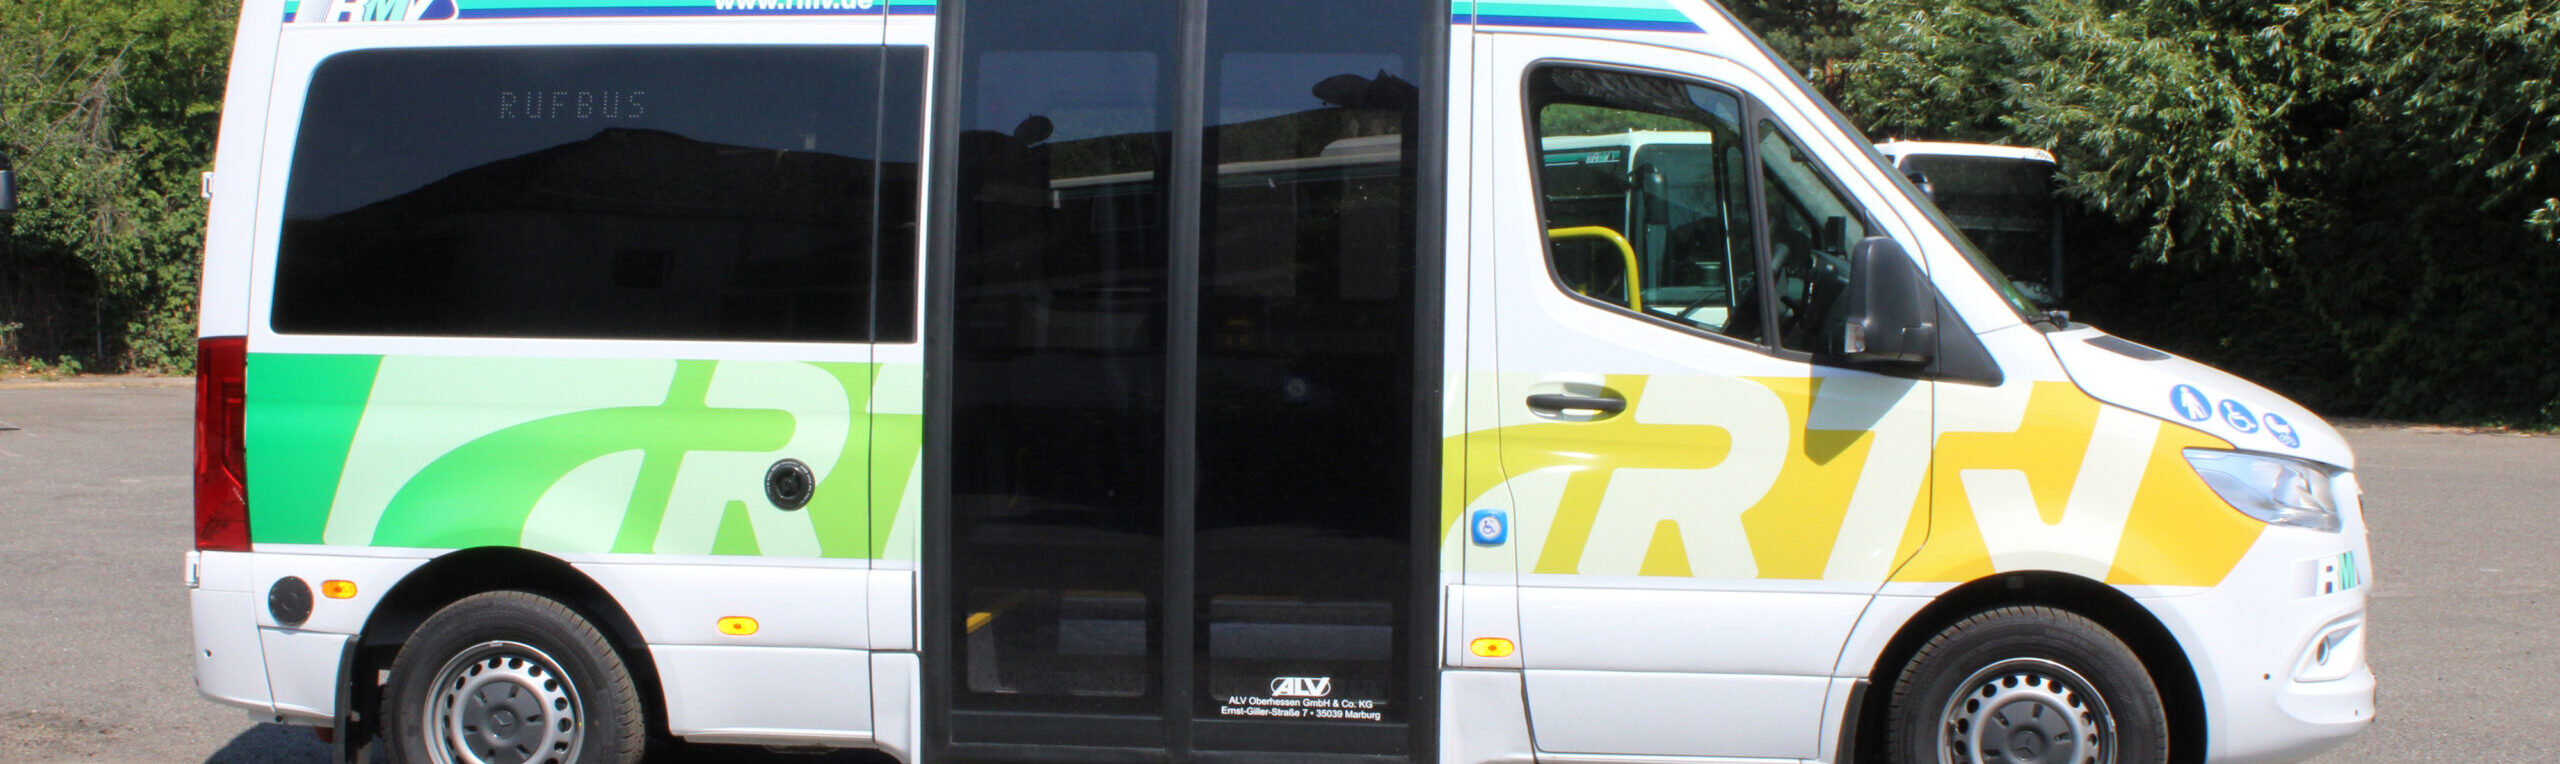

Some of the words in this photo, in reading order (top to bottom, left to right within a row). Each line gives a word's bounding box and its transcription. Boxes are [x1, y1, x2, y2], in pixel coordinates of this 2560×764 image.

[500, 91, 645, 118] RUFBUS
[1271, 676, 1331, 697] ALV
[1228, 696, 1246, 705] ALV
[1248, 697, 1300, 706] Oberhessen
[1302, 698, 1331, 707] GmbH
[1341, 700, 1356, 708] Co.
[1358, 700, 1374, 709] KG
[1302, 709, 1308, 717] 7
[1316, 709, 1343, 718] 35039
[1345, 711, 1381, 721] Marburg
